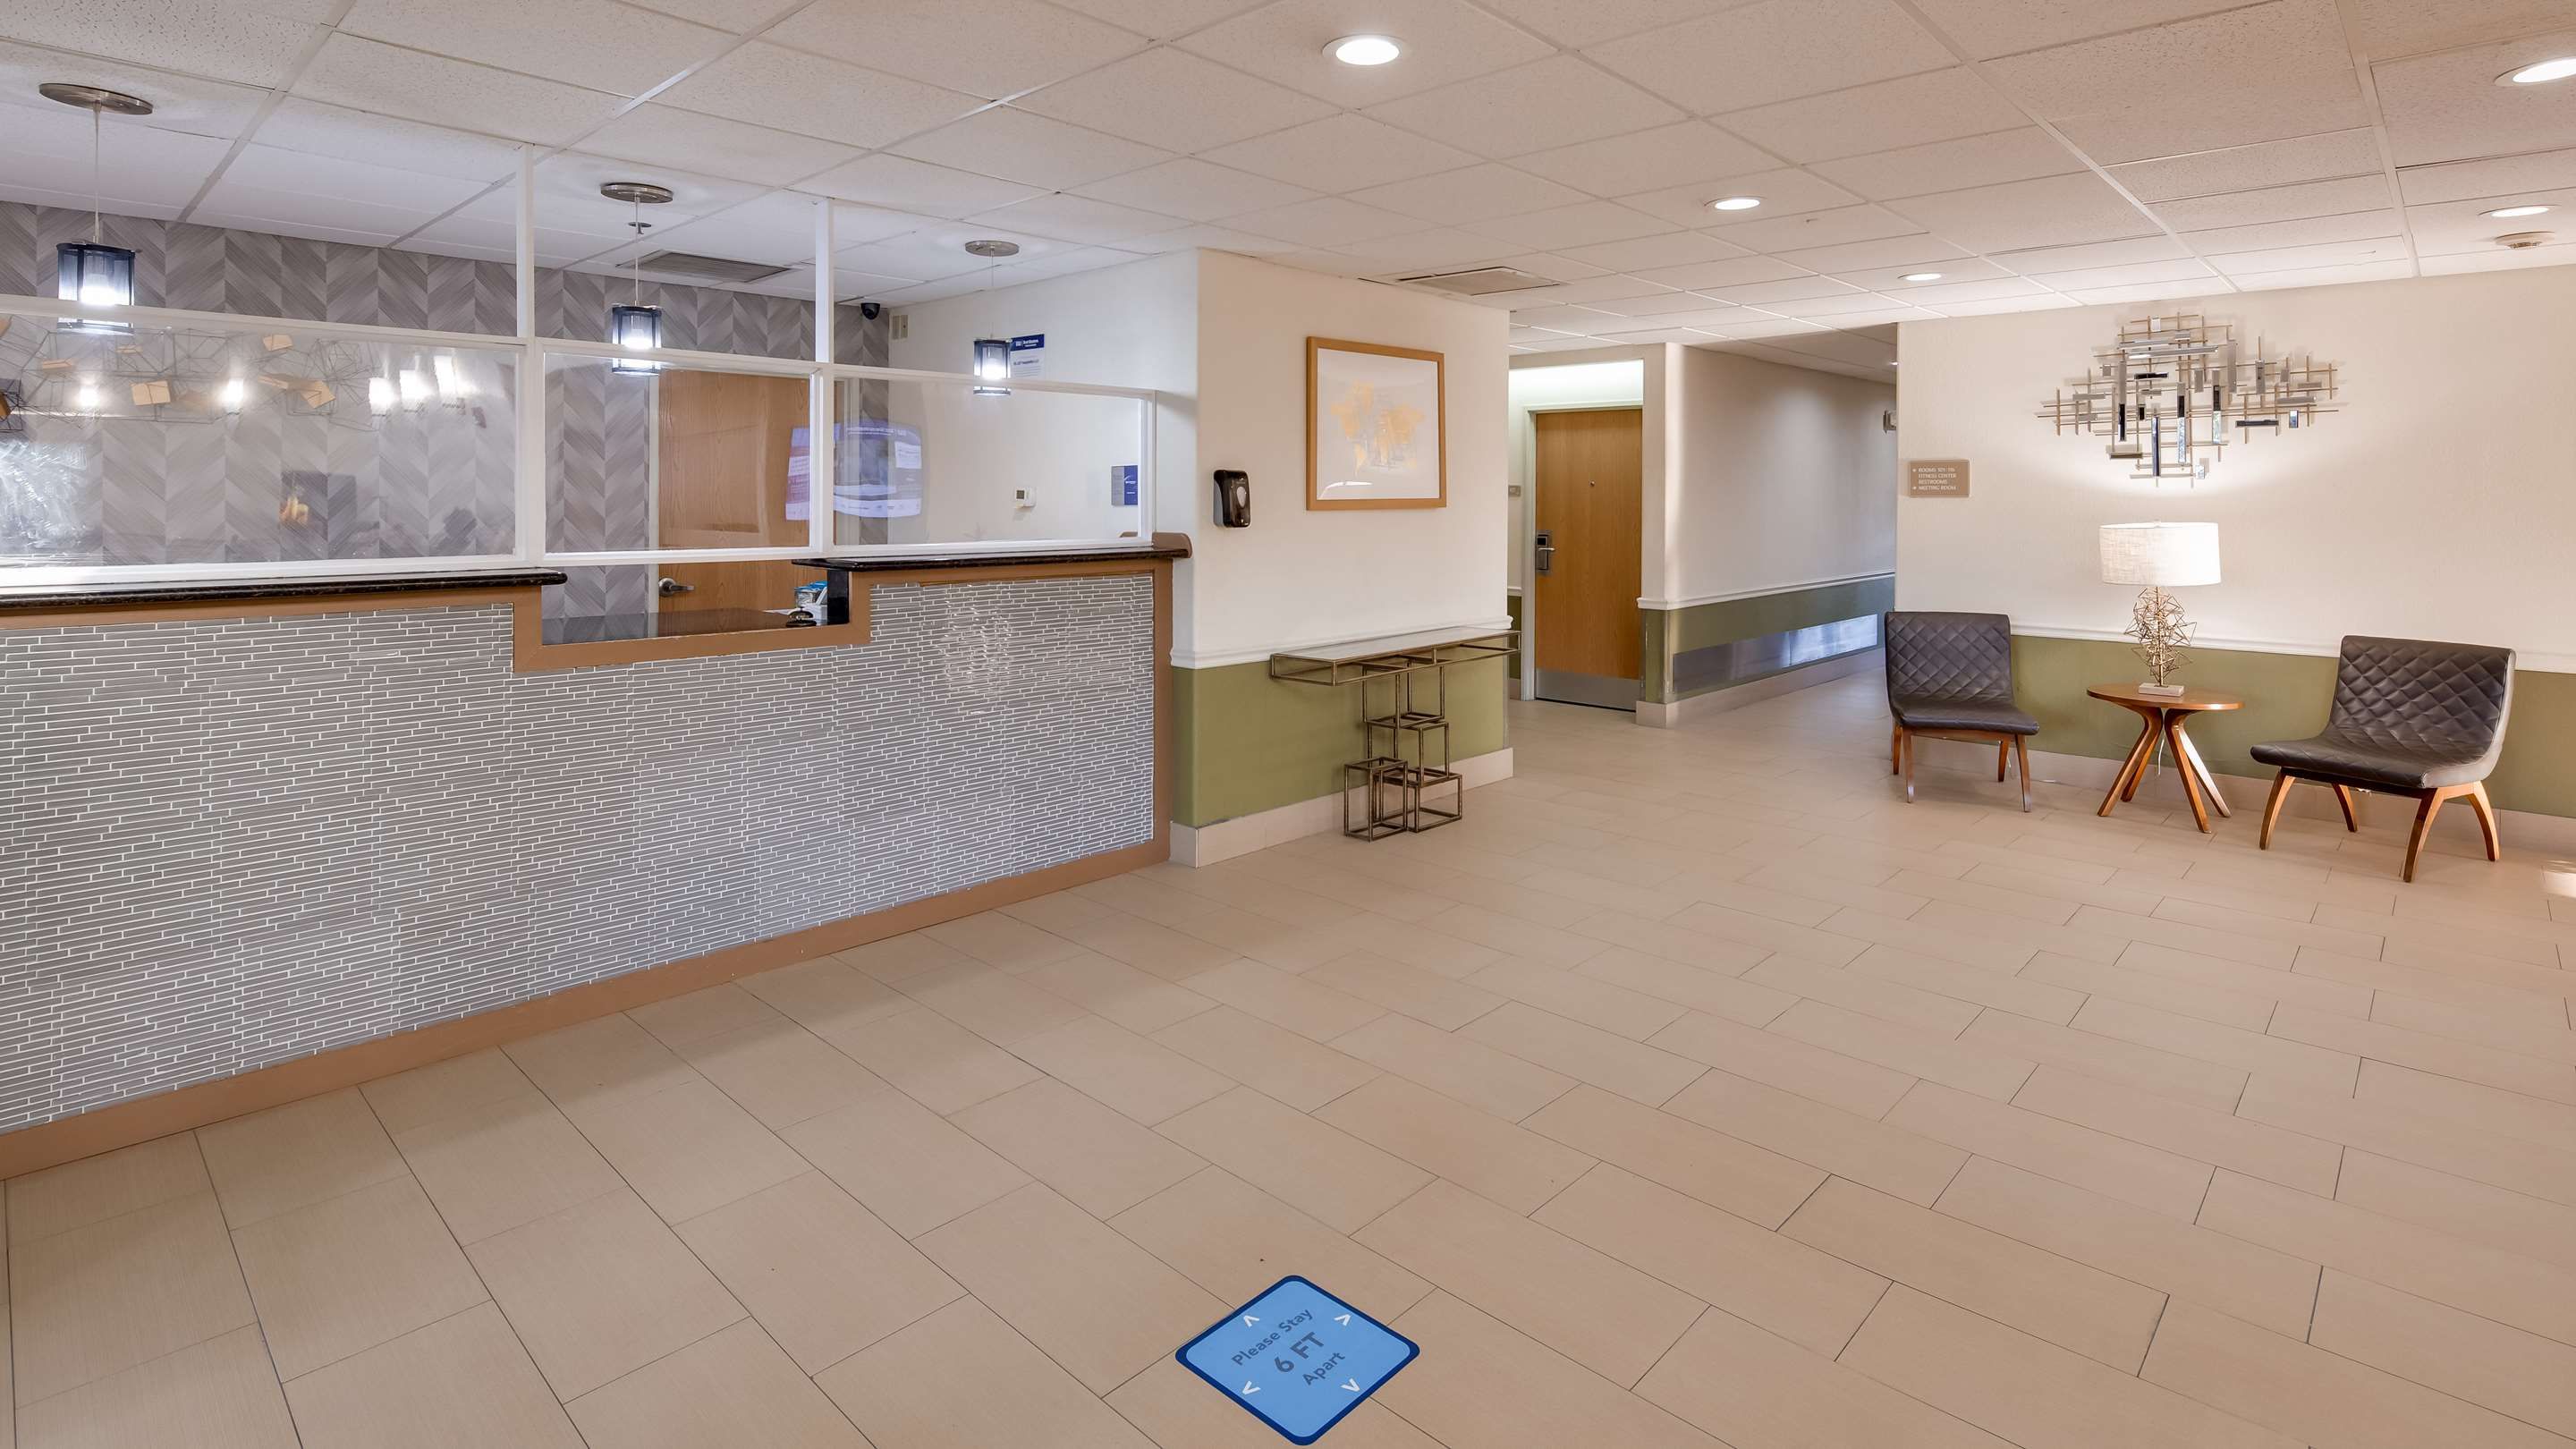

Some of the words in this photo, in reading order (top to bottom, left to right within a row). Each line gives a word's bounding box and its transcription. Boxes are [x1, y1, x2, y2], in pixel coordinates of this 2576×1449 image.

[1231, 1332, 1281, 1366] Please
[1278, 1309, 1313, 1333] Stay
[1274, 1356, 1295, 1373] 6
[1290, 1331, 1325, 1360] FT
[1301, 1352, 1346, 1385] Apart
